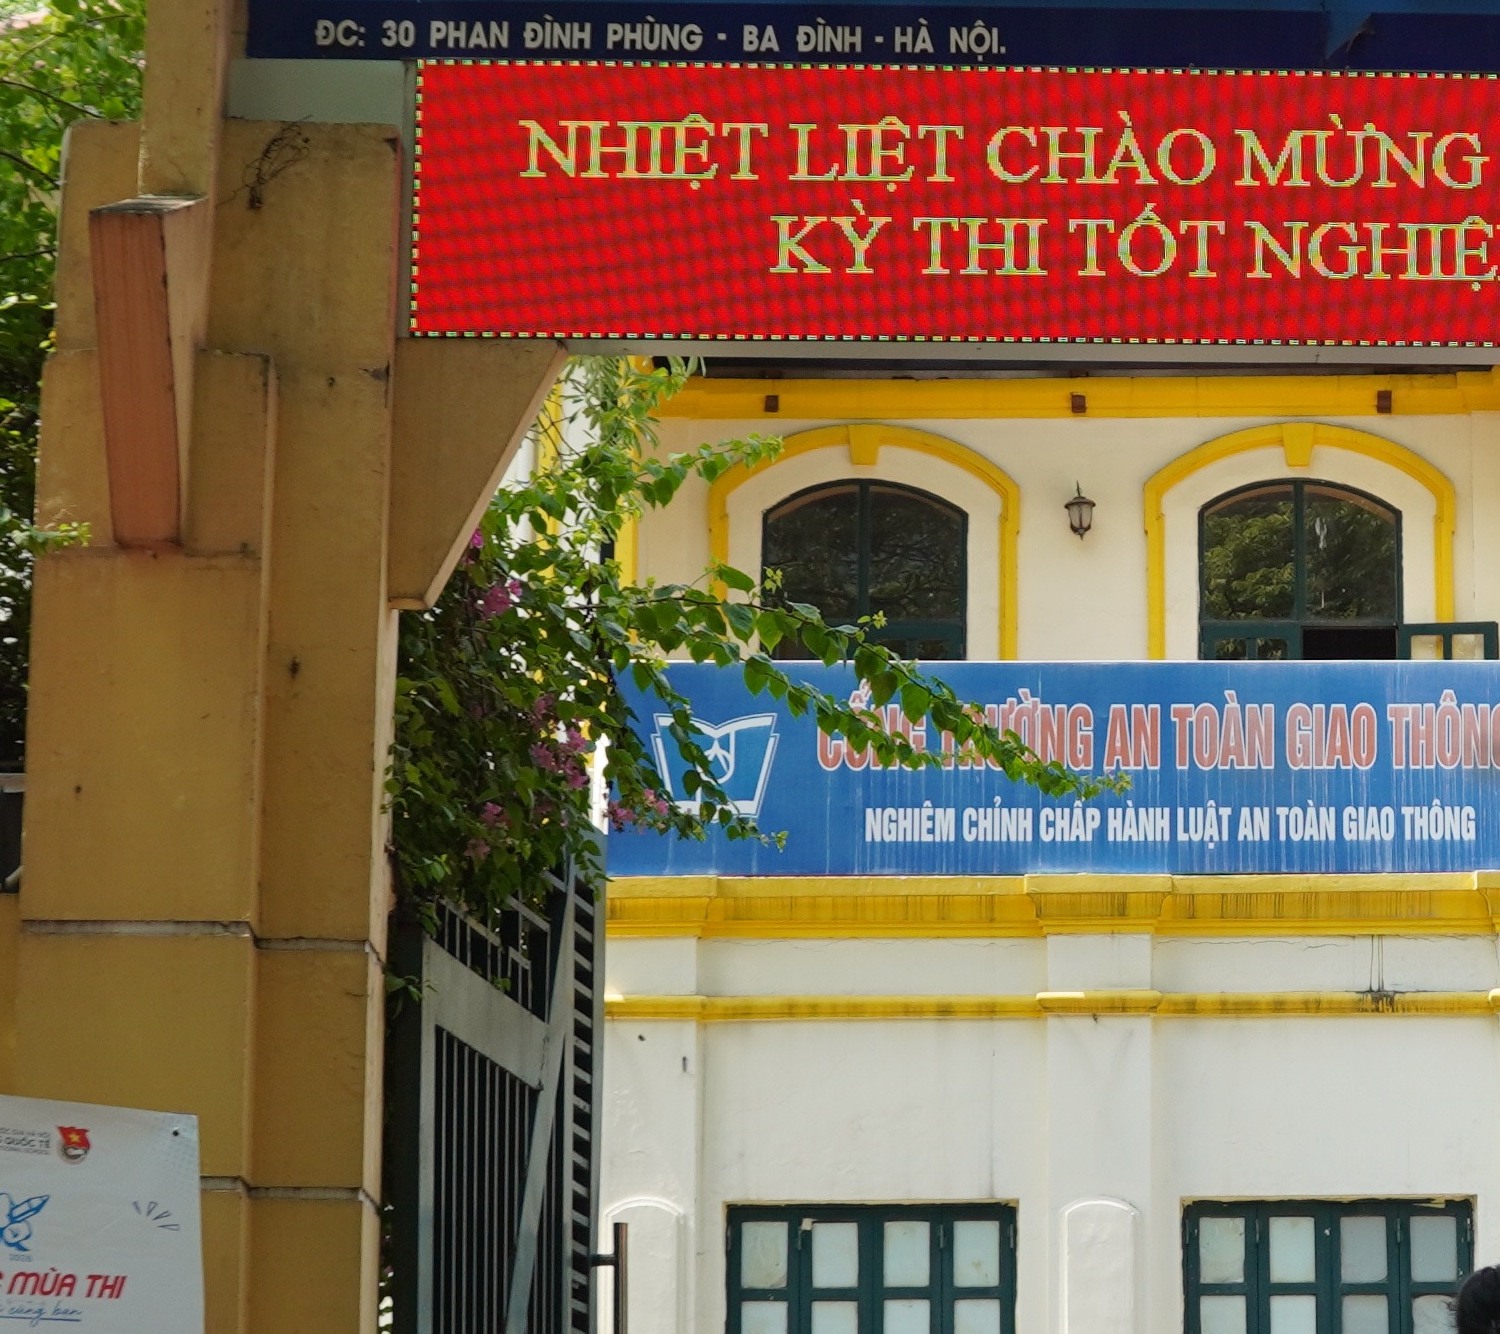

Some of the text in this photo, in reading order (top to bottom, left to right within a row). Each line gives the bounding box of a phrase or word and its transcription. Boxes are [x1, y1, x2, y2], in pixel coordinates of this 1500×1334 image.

[315, 15, 1007, 61] ĐC: 30 PHAN ĐÌNH PHÙNG BA ĐÌNH HÀ NỘI.
[518, 114, 769, 190] NHIỆT
[789, 116, 964, 193] LIỆT
[987, 110, 1216, 186] CHÀO
[1234, 114, 1490, 189] MỪNG
[769, 199, 891, 276] KỲ
[913, 217, 1047, 276] THI
[1069, 203, 1226, 278] TỐT
[1104, 701, 1161, 771] AN
[1171, 689, 1276, 771] TOÀN
[1283, 701, 1375, 771] GIAO
[864, 800, 956, 843] NGHIÊM
[962, 795, 1034, 843] CHỈNH
[1107, 799, 1171, 843] HÀNH
[1176, 803, 1233, 851] LUẬT
[1237, 807, 1271, 843] AN
[1277, 801, 1336, 842] TOÀN
[1342, 807, 1394, 842] GIAO
[1400, 801, 1476, 842] THÔNG
[7, 1267, 78, 1297] MÙA
[85, 1274, 128, 1299] THI
